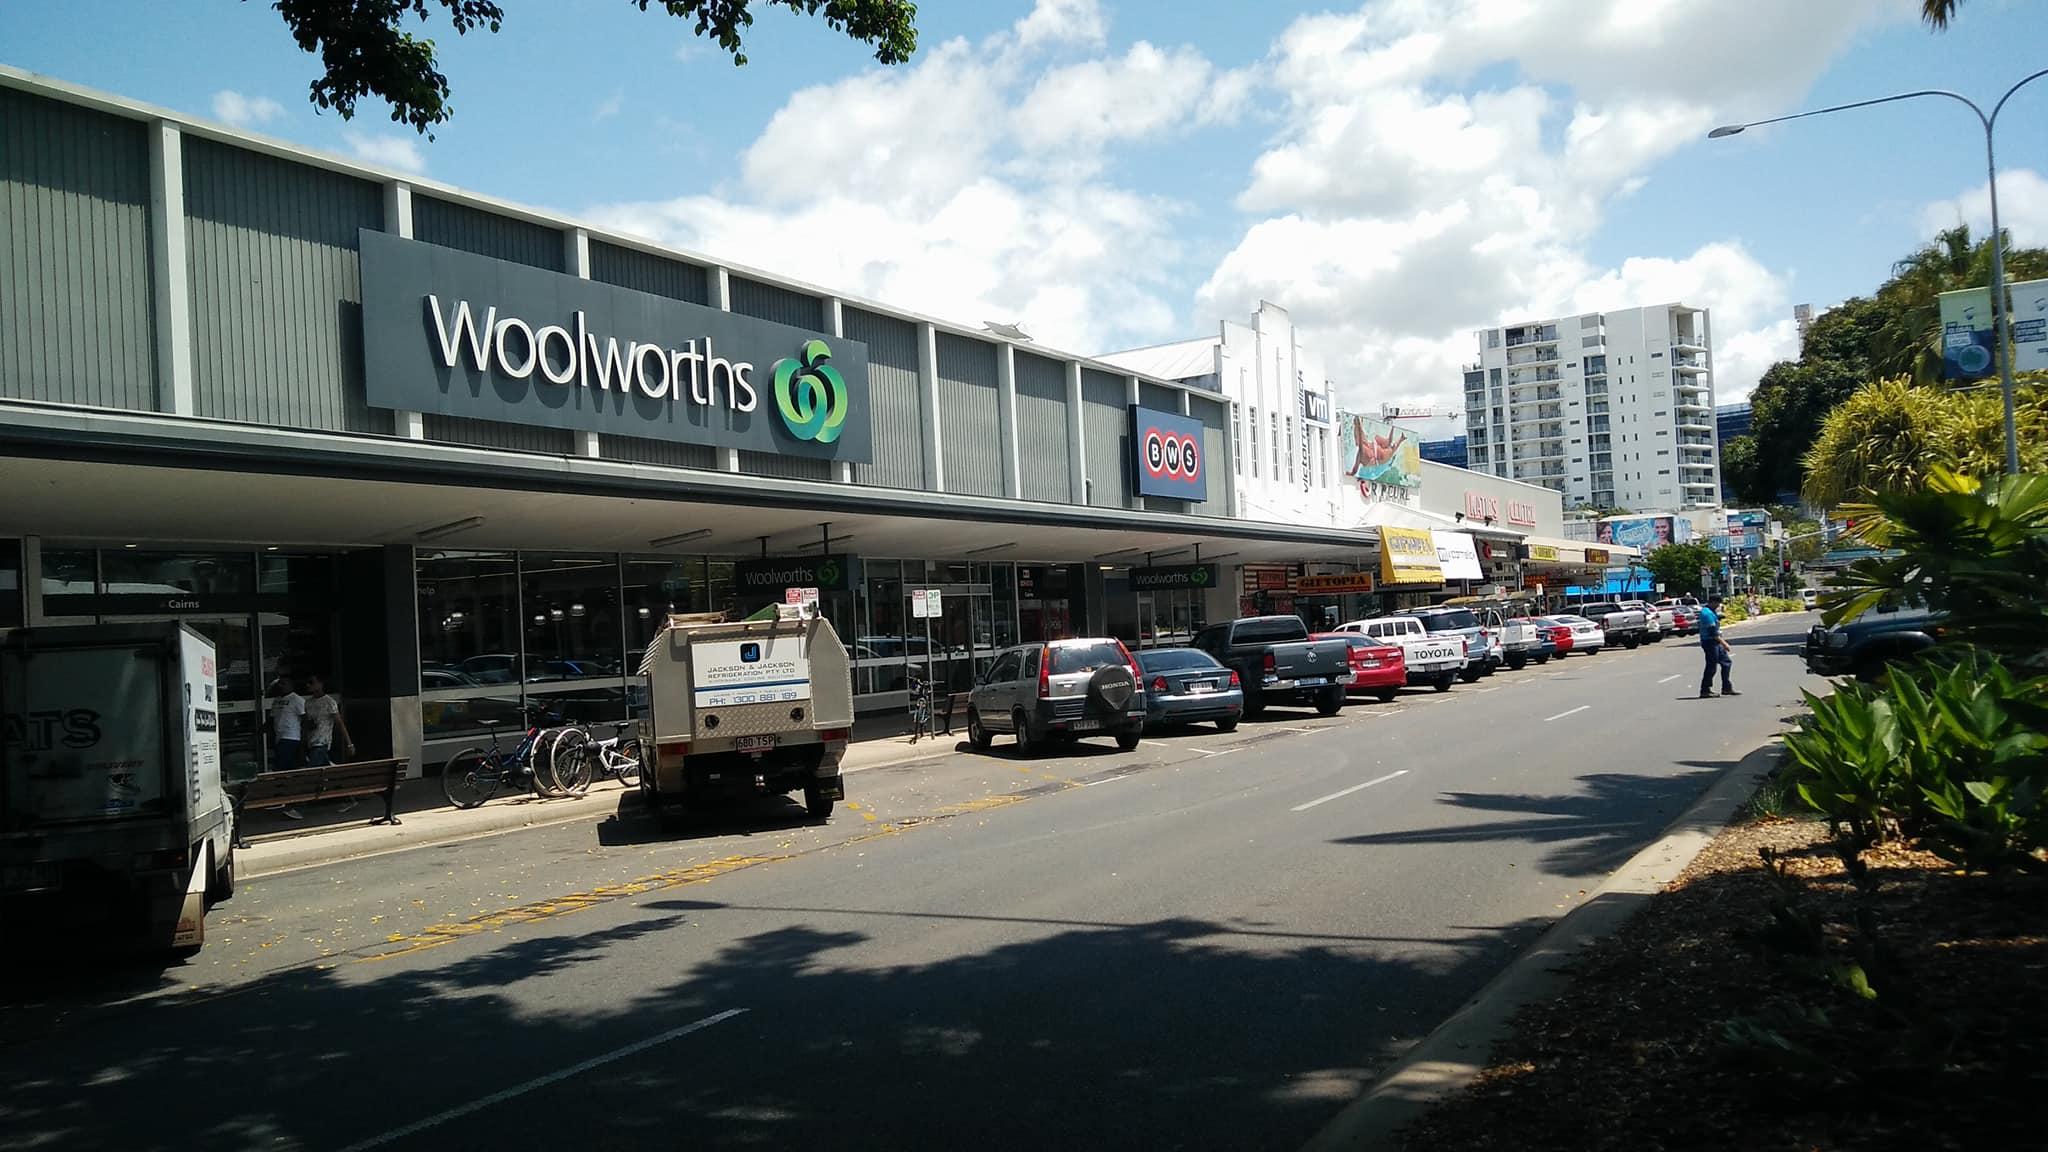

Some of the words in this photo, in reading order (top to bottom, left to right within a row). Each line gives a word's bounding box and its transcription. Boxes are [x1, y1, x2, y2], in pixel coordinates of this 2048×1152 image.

[428, 294, 758, 413] Woolworths
[1151, 443, 1194, 464] BWS
[1387, 486, 1410, 501] CURL
[745, 566, 814, 585] woolworths
[1136, 571, 1189, 585] woolworths
[168, 599, 200, 609] Cairns
[1414, 648, 1455, 659] TOYOTA
[708, 665, 745, 673] JACKSON
[758, 661, 795, 670] JACKSON
[708, 670, 763, 679] REFRIGERATION
[1101, 681, 1130, 691] HONDA
[709, 697, 726, 705] PH:
[733, 695, 755, 703] 1300
[757, 735, 775, 746] TSP
